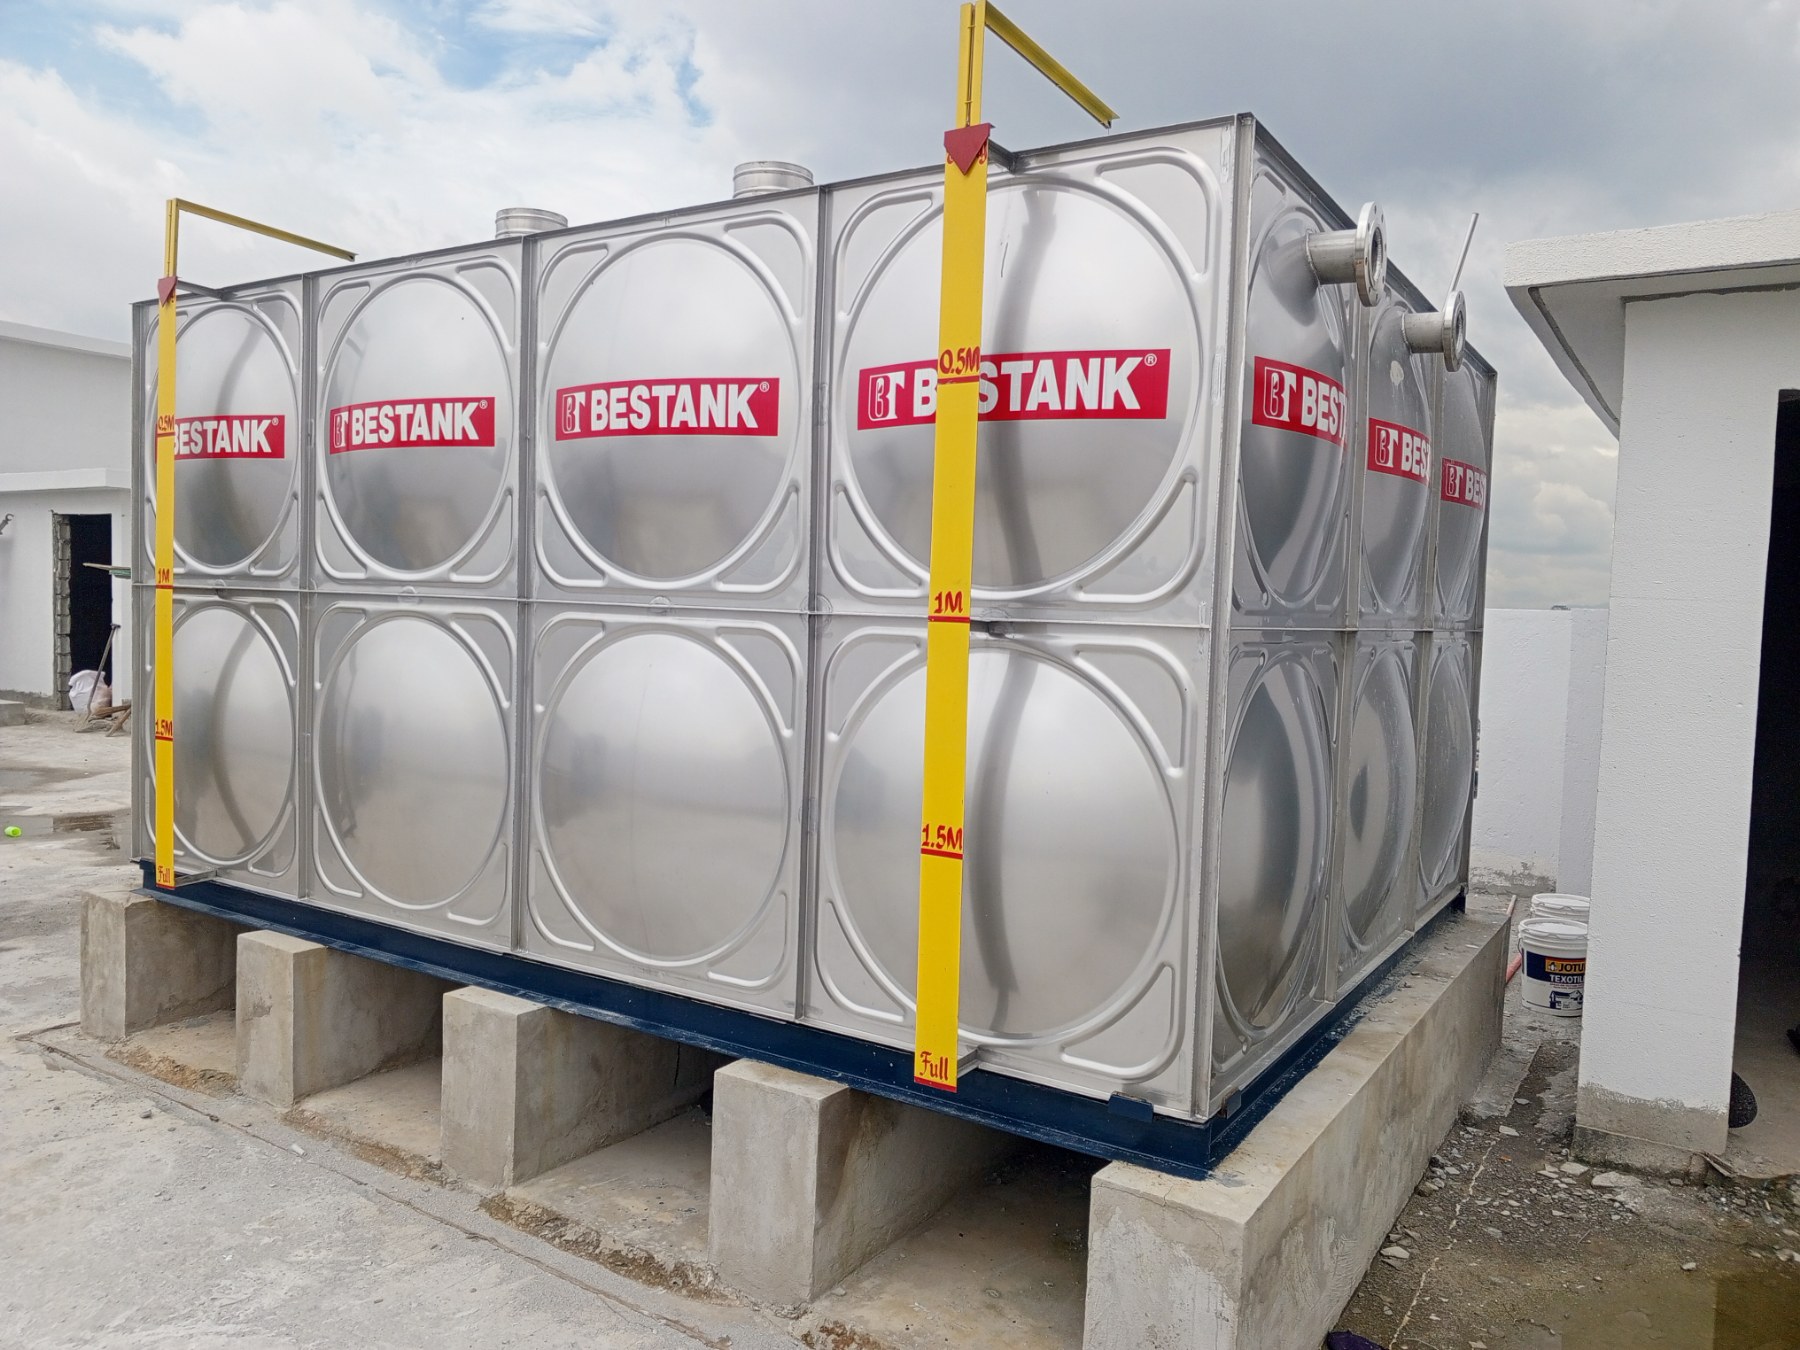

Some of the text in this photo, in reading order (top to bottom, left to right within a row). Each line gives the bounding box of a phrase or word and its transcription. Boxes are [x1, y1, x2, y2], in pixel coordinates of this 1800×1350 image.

[940, 346, 980, 375] 0.5M
[158, 568, 170, 584] 1M
[934, 591, 963, 614] 1M
[922, 823, 963, 850] 1.5M
[919, 1051, 948, 1080] Full
